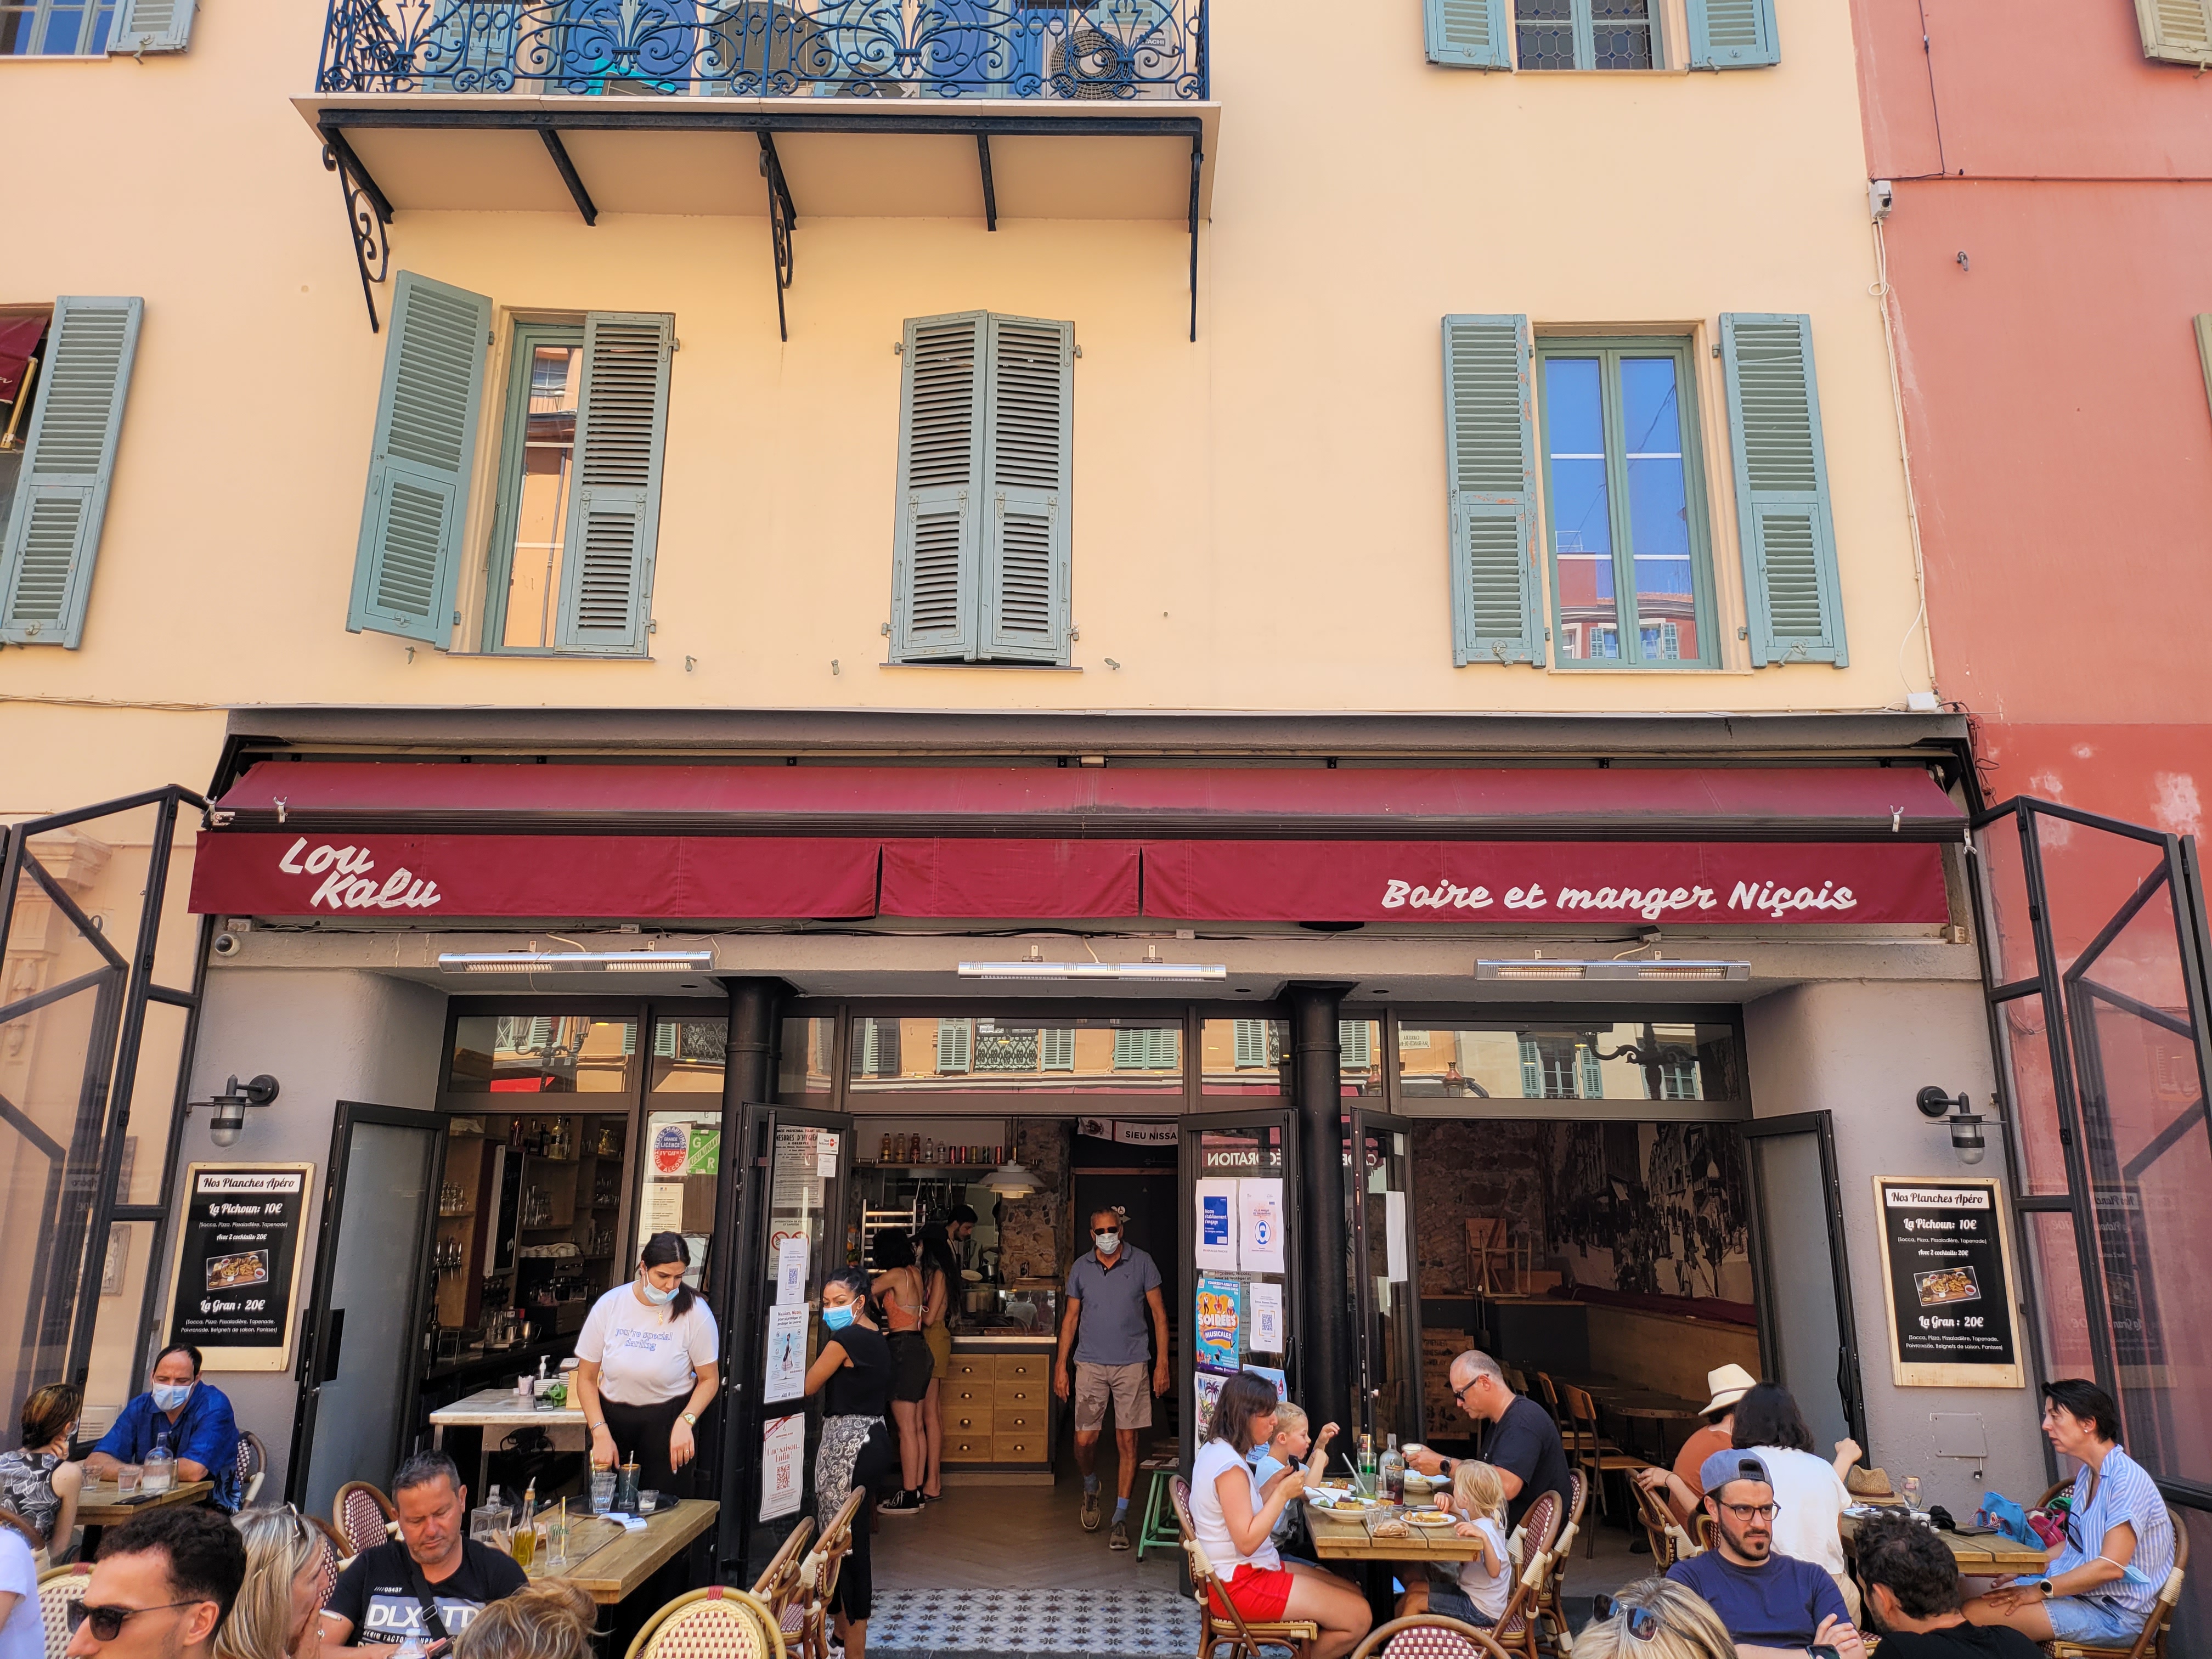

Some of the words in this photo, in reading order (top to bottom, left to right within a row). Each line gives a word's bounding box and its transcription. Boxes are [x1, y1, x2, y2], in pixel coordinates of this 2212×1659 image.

[278, 837, 374, 875] Lou
[310, 867, 441, 910] Kalu
[1381, 879, 1493, 910] Boire
[1503, 884, 1547, 910] et
[1556, 884, 1717, 920] manger
[1727, 880, 1857, 917] Niçois
[1125, 1131, 1147, 1139] SIEU
[692, 1137, 702, 1148] G
[707, 1157, 715, 1169] R
[204, 1177, 220, 1188] Nos
[222, 1177, 264, 1188] Planches
[267, 1177, 295, 1190] Apéro
[1891, 1192, 1908, 1202] Nos
[1910, 1192, 1953, 1203] Planches
[1954, 1193, 1983, 1206] Apéro
[209, 1203, 219, 1216] La
[264, 1203, 283, 1214] 10€
[1903, 1218, 1914, 1231] La
[1959, 1219, 1977, 1229] 10€
[200, 1300, 211, 1313] La
[212, 1299, 236, 1312] Gran
[245, 1299, 266, 1311] 20€
[1198, 1311, 1236, 1327] SOIRÉES
[1918, 1316, 1929, 1329] La
[1931, 1316, 1955, 1328] Gran
[1964, 1316, 1984, 1327] 20€
[615, 1328, 641, 1337] you're
[642, 1331, 673, 1341] special
[1205, 1330, 1232, 1340] MUSICALES
[624, 1338, 656, 1351] darling
[366, 1604, 422, 1628] DLX
[383, 1634, 407, 1644] FACTO
